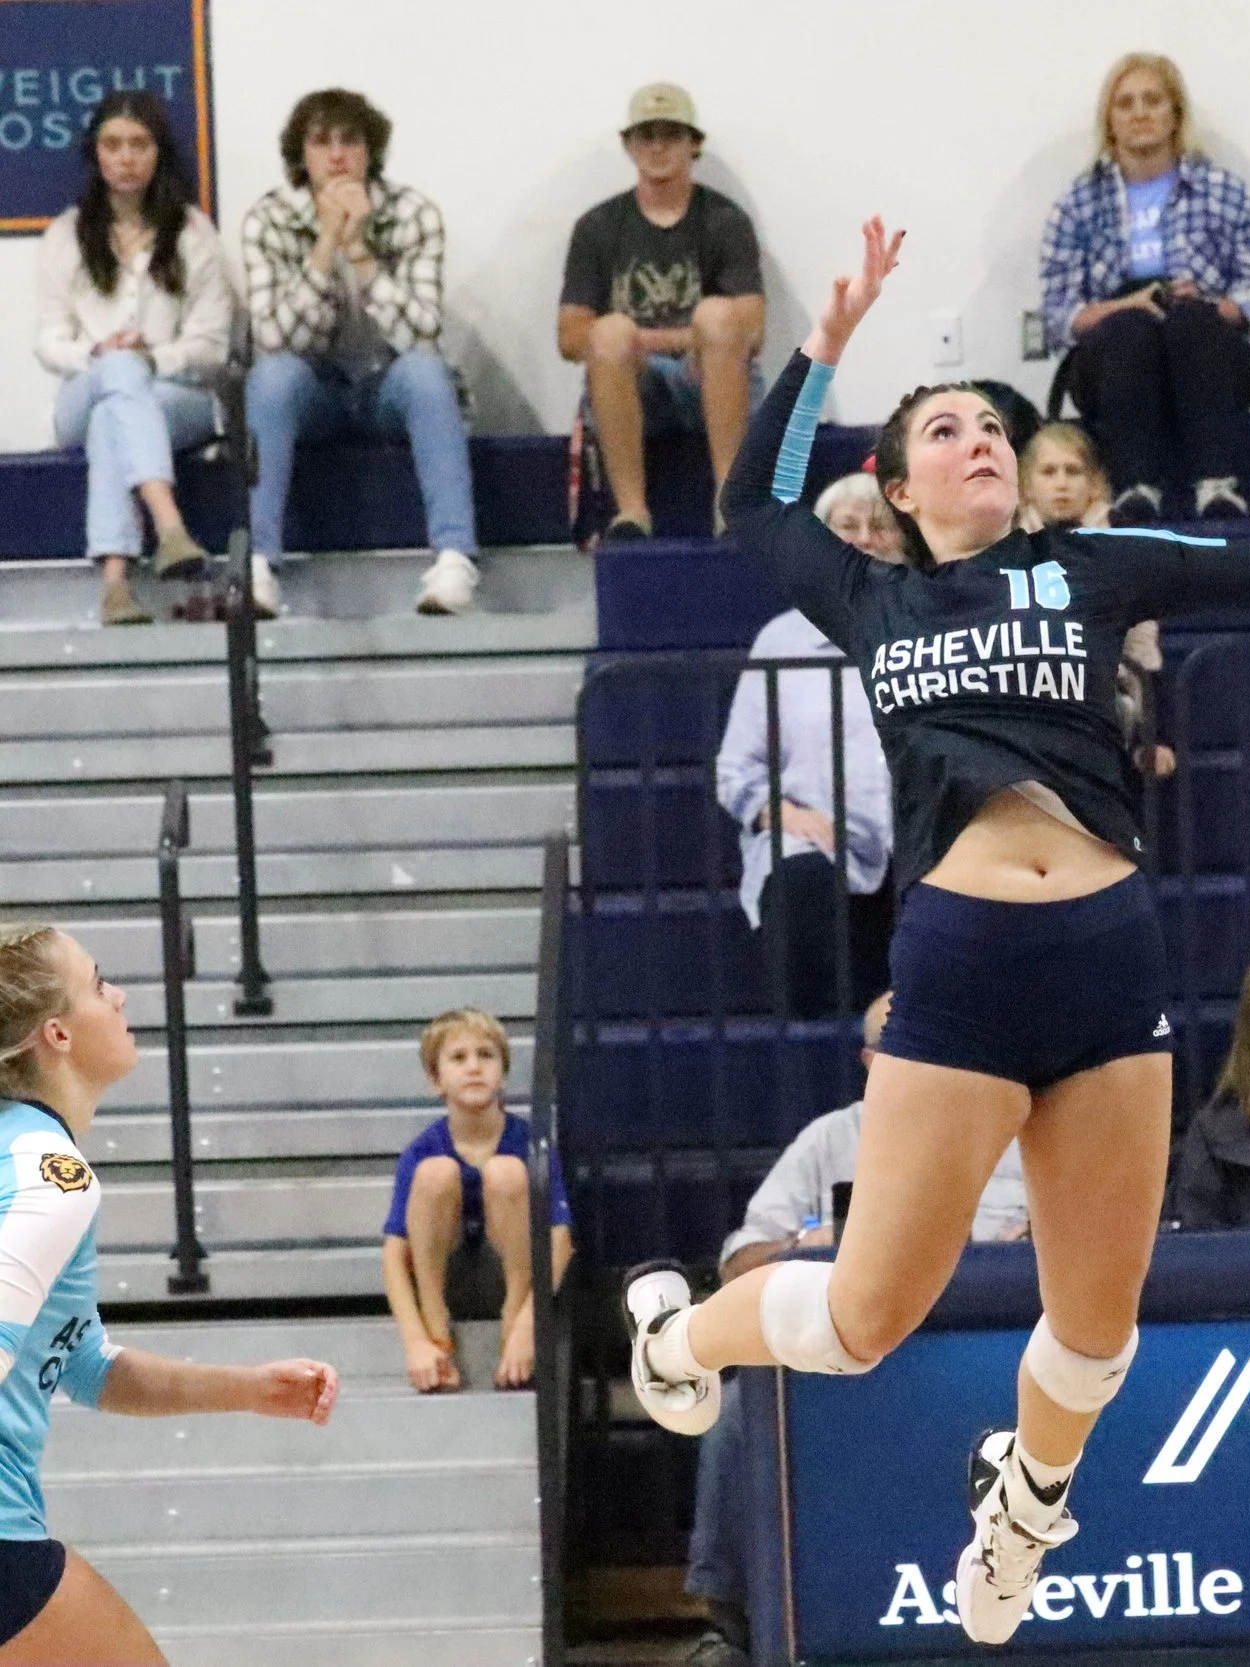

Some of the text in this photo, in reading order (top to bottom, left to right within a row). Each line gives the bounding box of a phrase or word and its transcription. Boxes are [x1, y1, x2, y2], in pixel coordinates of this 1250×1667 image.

[1000, 561, 1071, 611] 16
[871, 620, 1088, 680] ASHEVILLE
[874, 661, 1085, 715] CHRISTIAN
